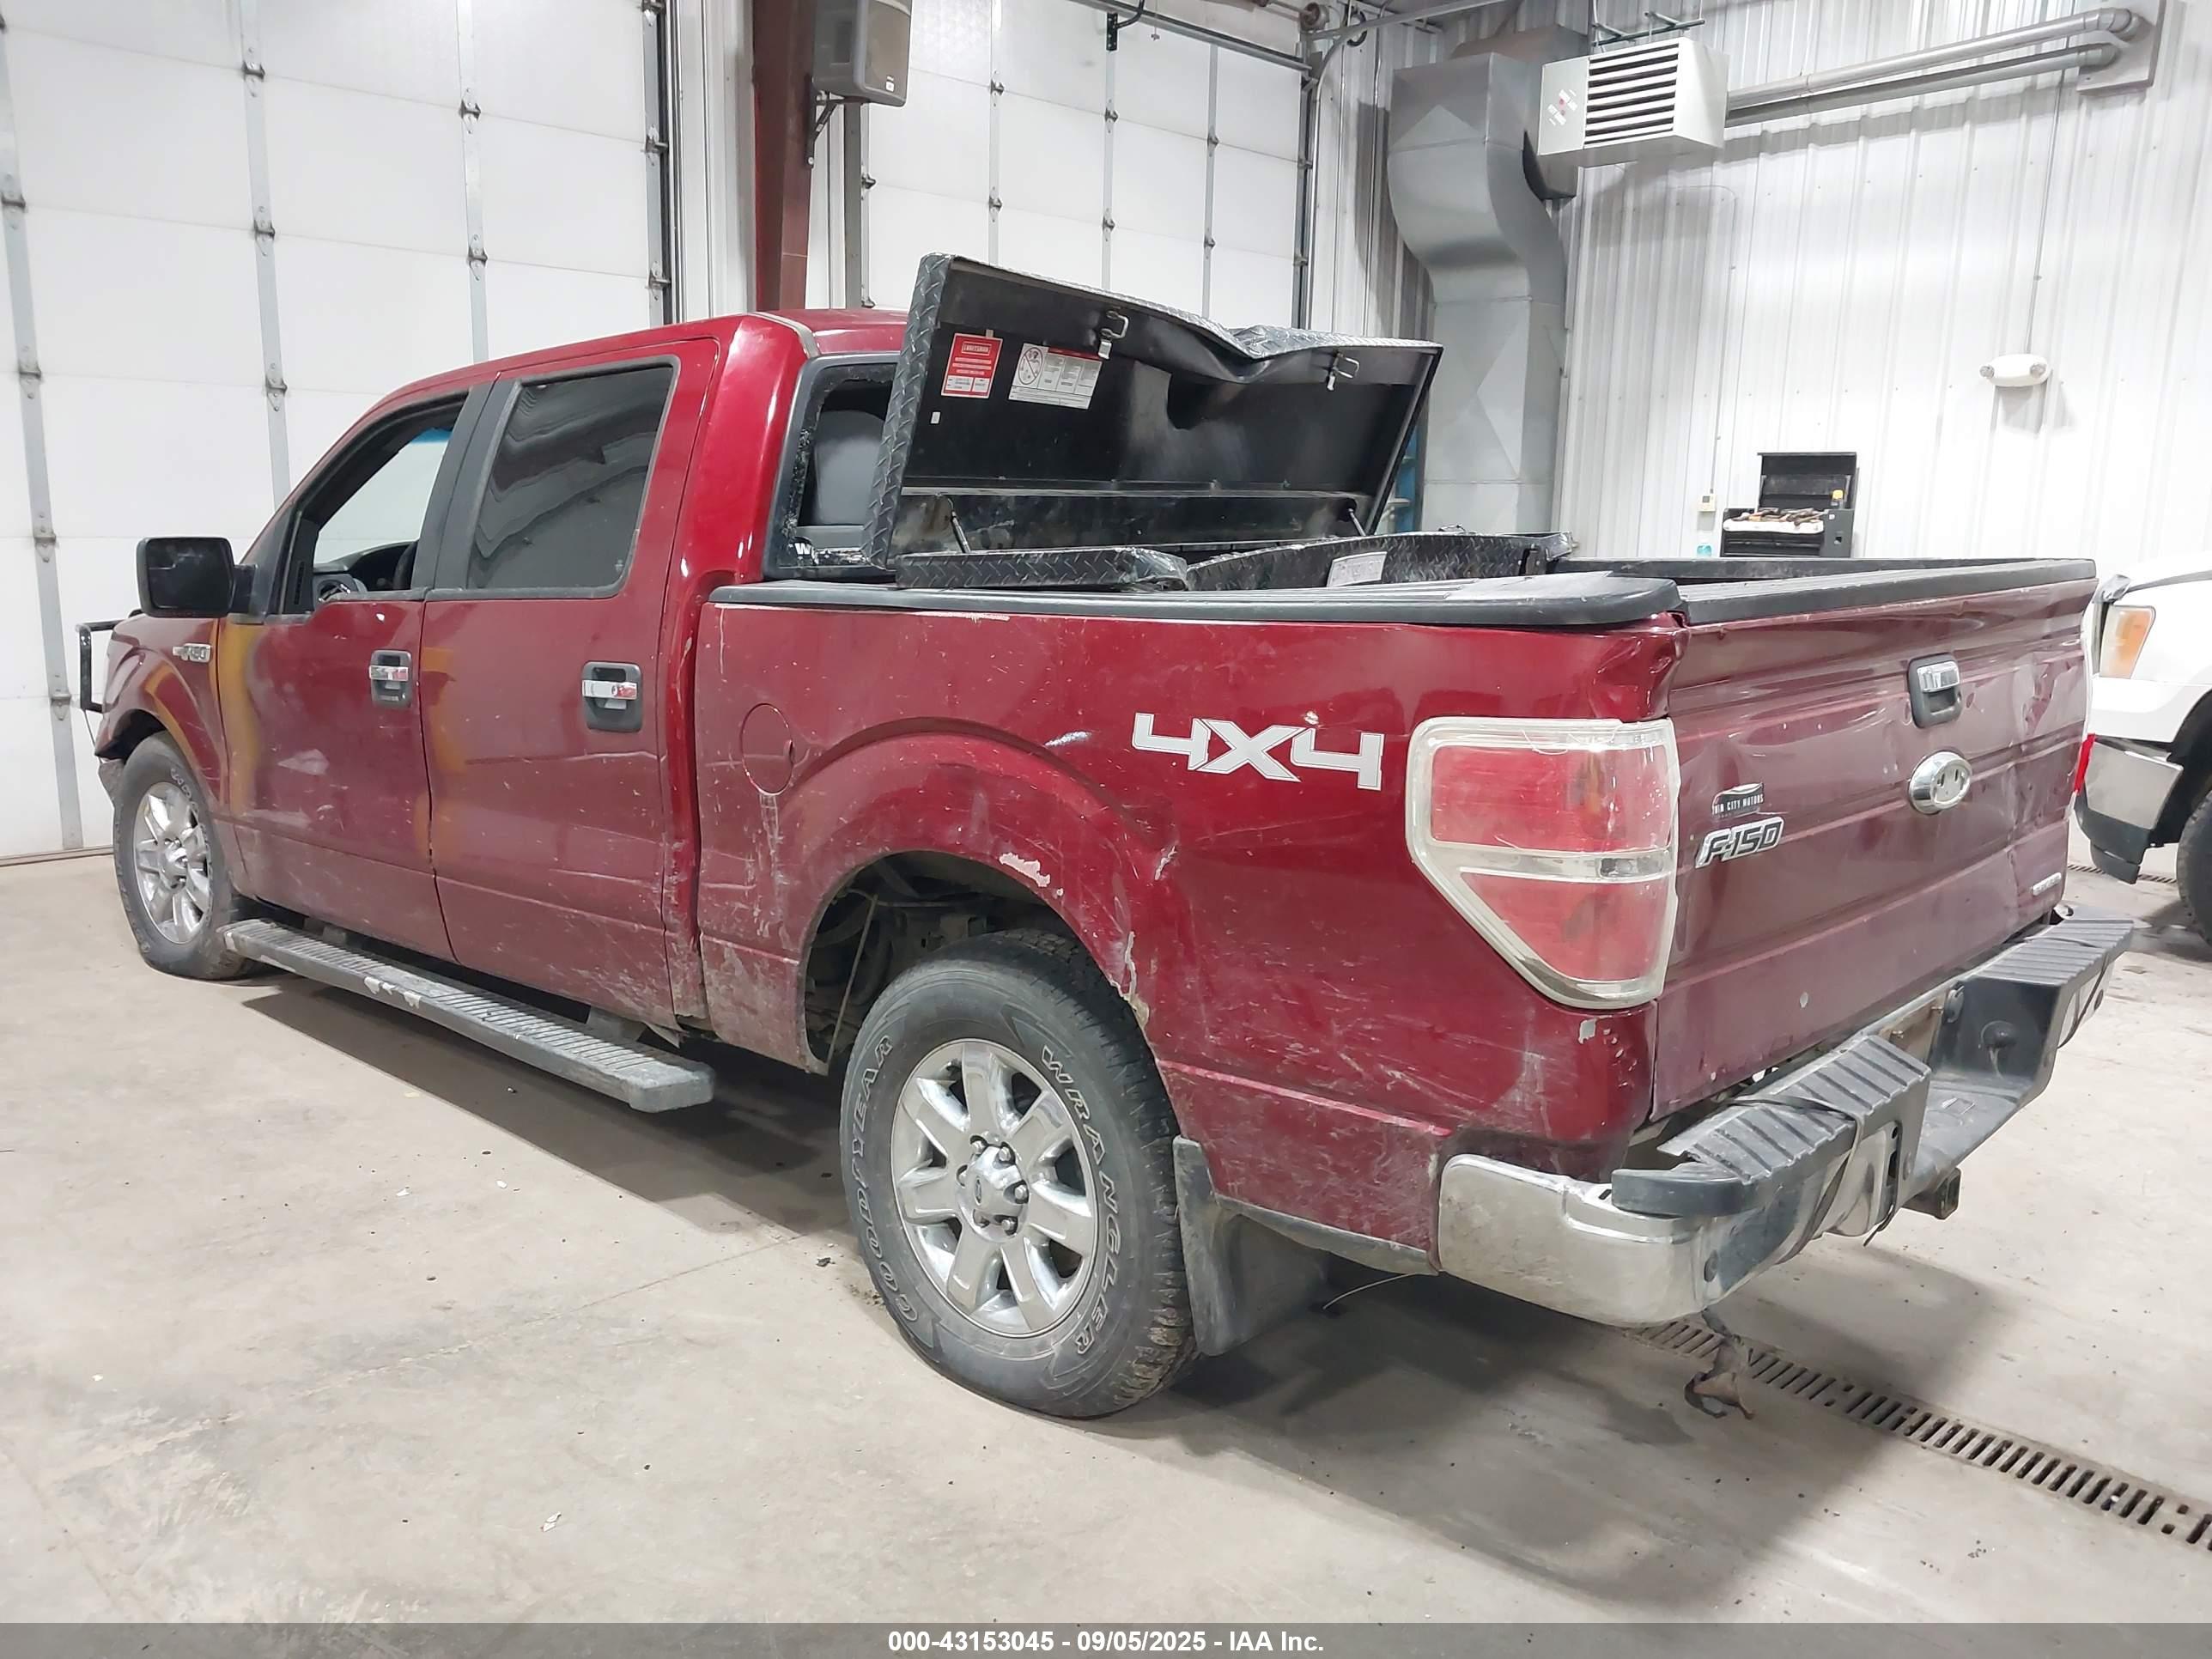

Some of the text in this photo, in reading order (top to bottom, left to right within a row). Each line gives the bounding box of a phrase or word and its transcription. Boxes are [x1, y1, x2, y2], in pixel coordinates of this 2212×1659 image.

[1695, 817, 1784, 869] F-150
[1727, 800, 1741, 811] CITY
[852, 1035, 918, 1322] GOODYEAR
[1042, 1044, 1121, 1355] WRANGLER
